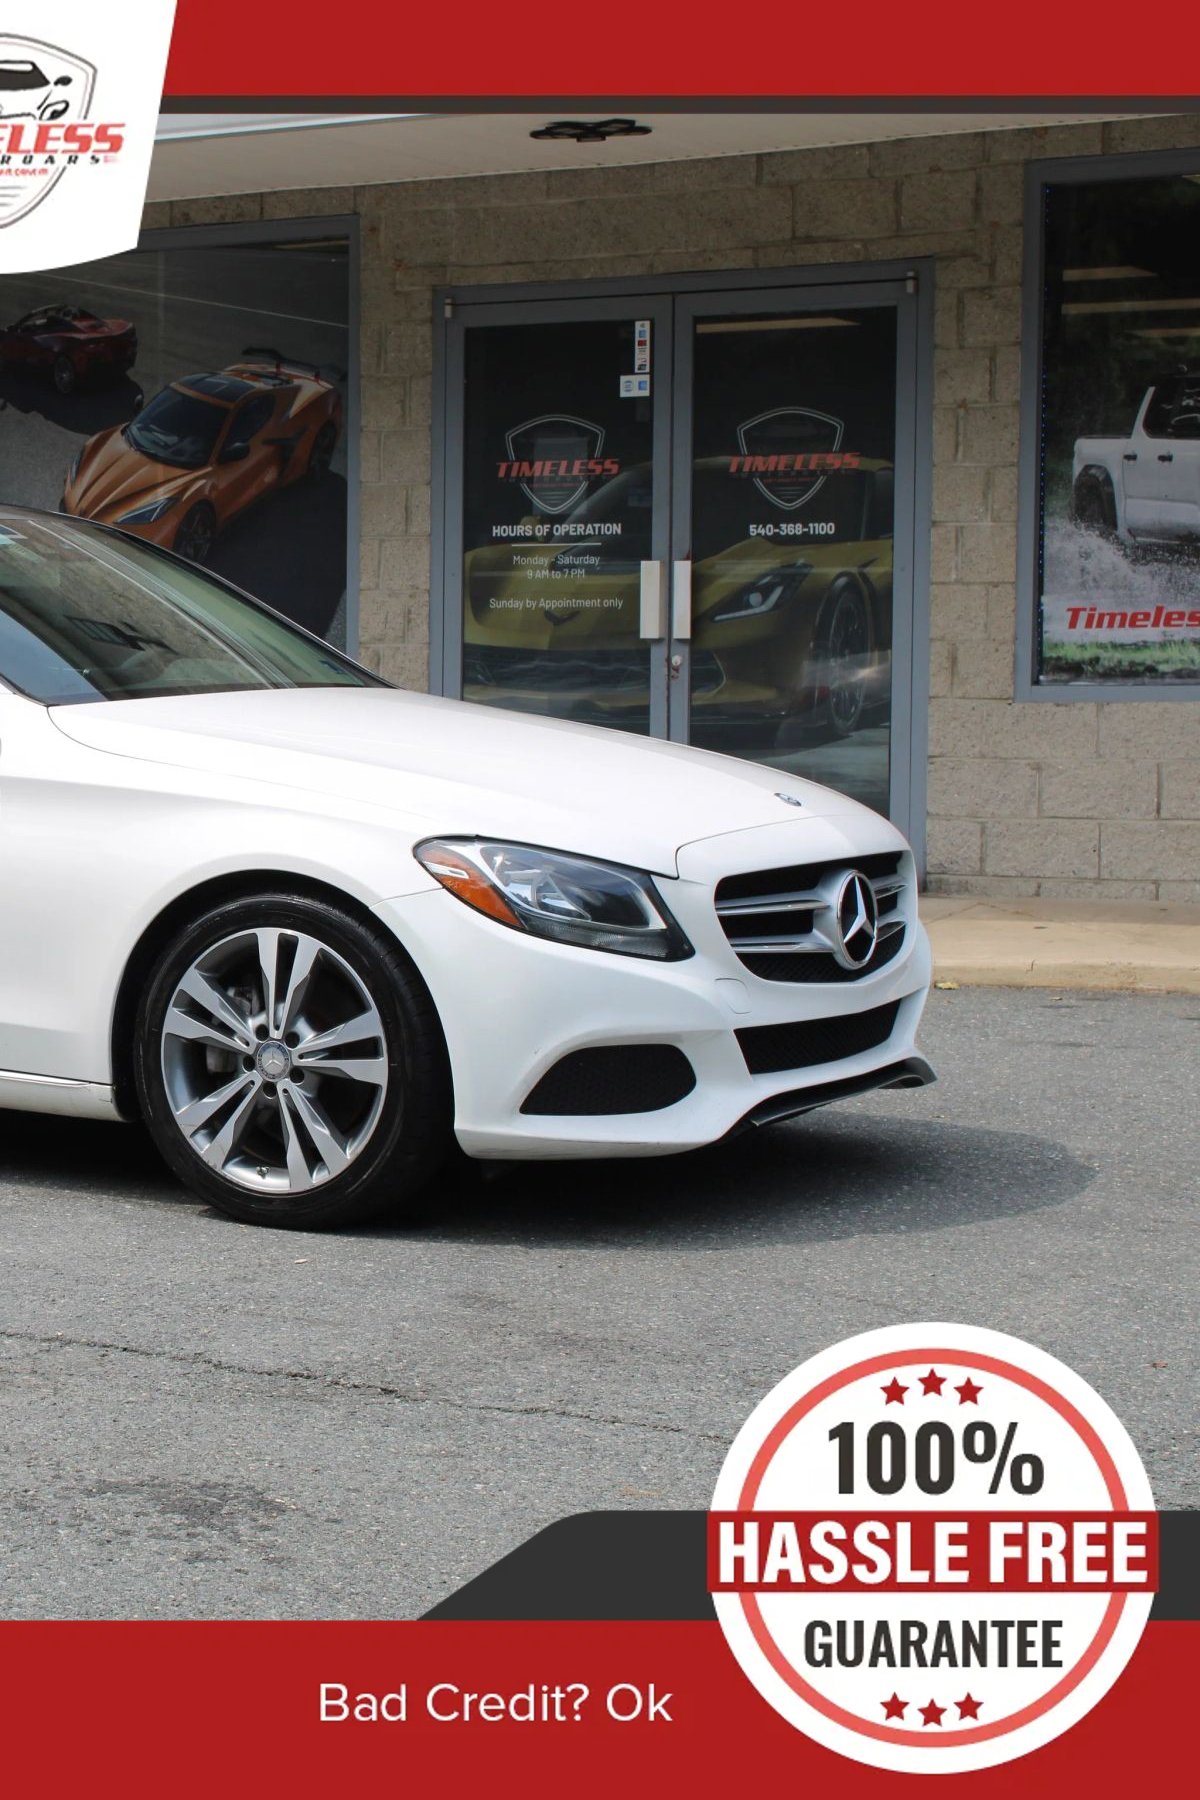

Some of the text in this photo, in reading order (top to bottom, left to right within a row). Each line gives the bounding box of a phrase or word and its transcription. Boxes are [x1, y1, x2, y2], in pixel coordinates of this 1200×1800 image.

[496, 458, 620, 478] TIMELESS
[728, 452, 861, 473] TIMELESS
[492, 523, 622, 537] HOURS OF OPERATION
[749, 522, 836, 536] 540-368-1100
[512, 555, 549, 567] Monday
[557, 554, 601, 567] Saturday
[527, 568, 585, 579] 9 AM to 7 PM
[489, 597, 624, 610] Sunday by Appointment only
